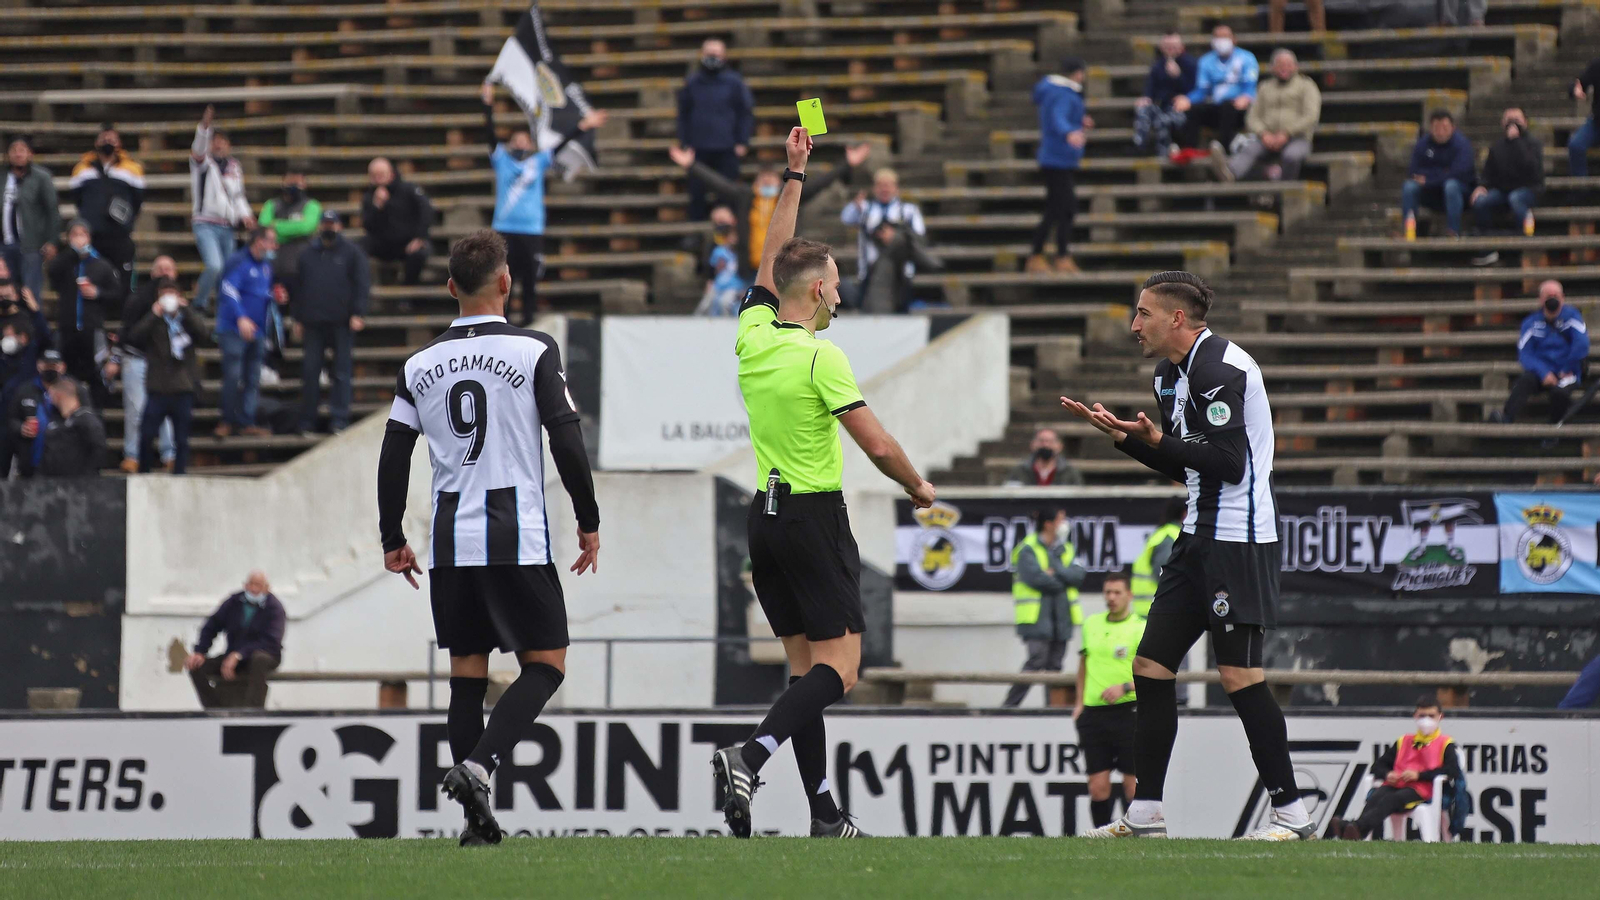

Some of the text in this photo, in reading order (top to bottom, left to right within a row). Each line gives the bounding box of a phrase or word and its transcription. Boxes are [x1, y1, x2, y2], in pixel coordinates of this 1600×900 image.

[416, 354, 526, 397] PITO CAMACHO
[445, 379, 488, 467] 9
[661, 421, 750, 440] LA BALON
[984, 516, 1123, 572] BANA
[1281, 505, 1393, 573] IGÜEY
[928, 743, 1087, 775] PINTUR
